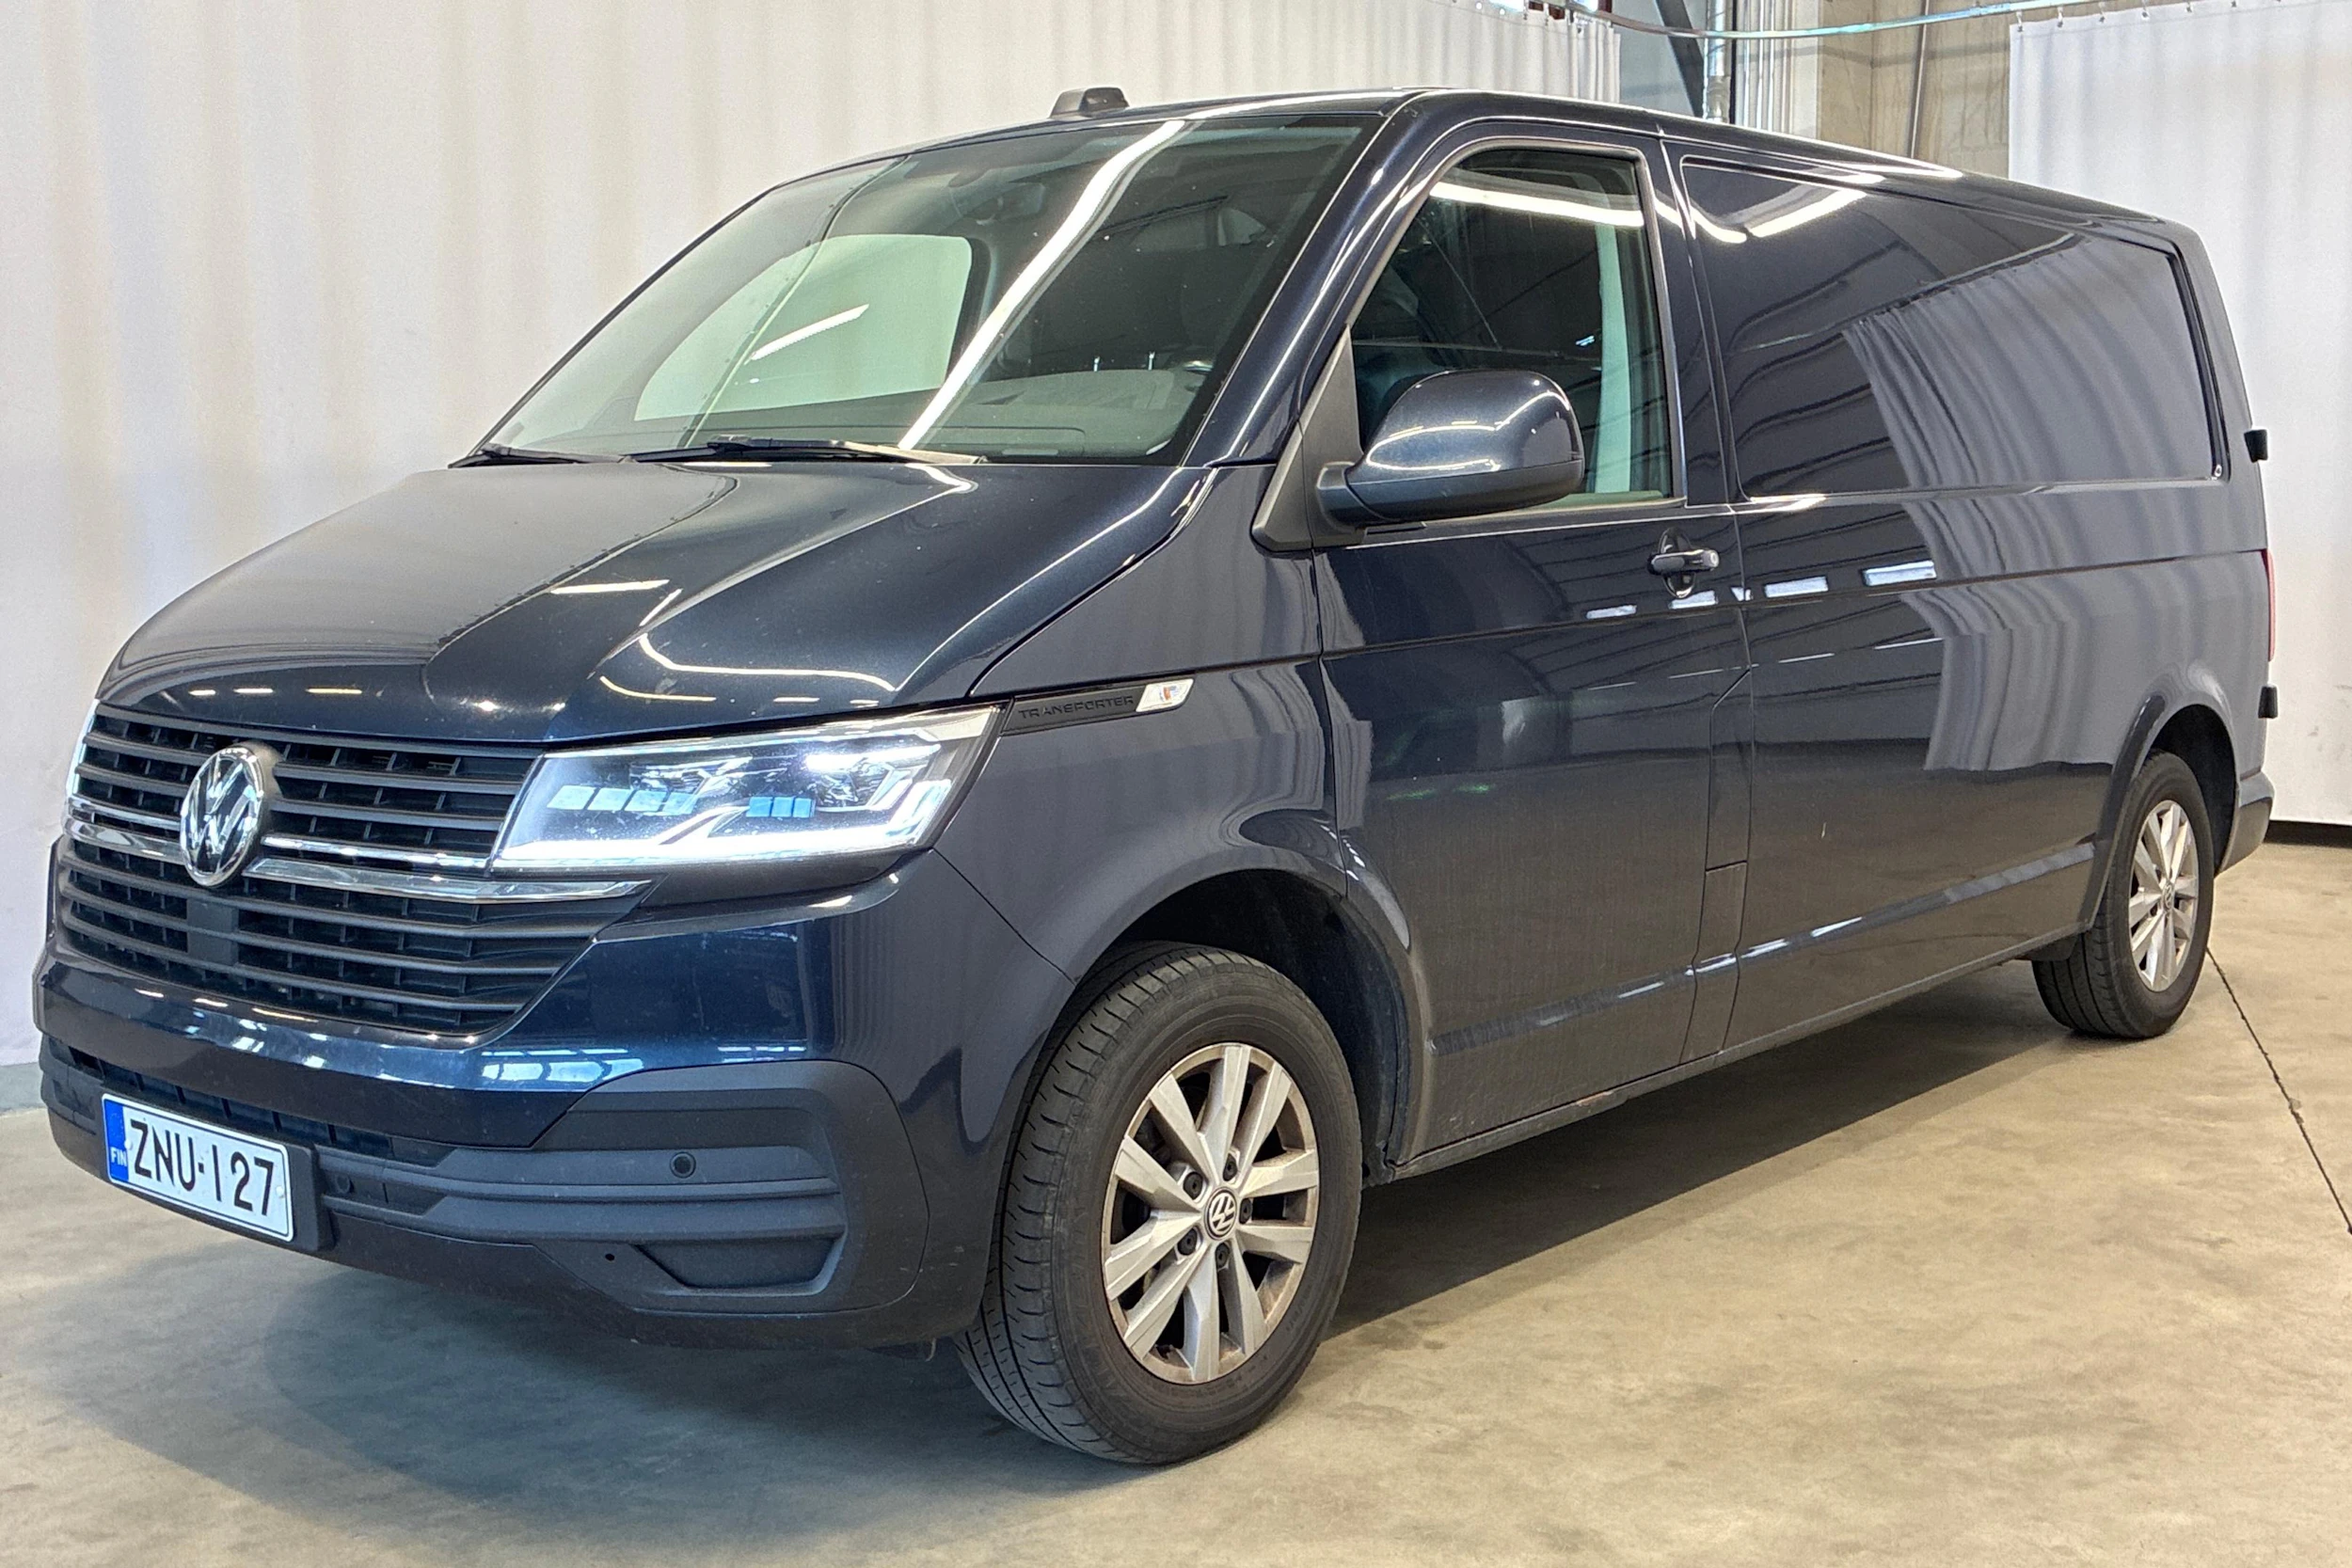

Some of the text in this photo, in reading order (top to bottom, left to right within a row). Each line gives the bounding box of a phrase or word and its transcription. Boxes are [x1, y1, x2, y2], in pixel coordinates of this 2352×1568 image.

[1018, 695, 1135, 720] TRANSPORTER
[110, 1146, 127, 1167] FIN
[130, 1117, 275, 1216] ZNU-127
